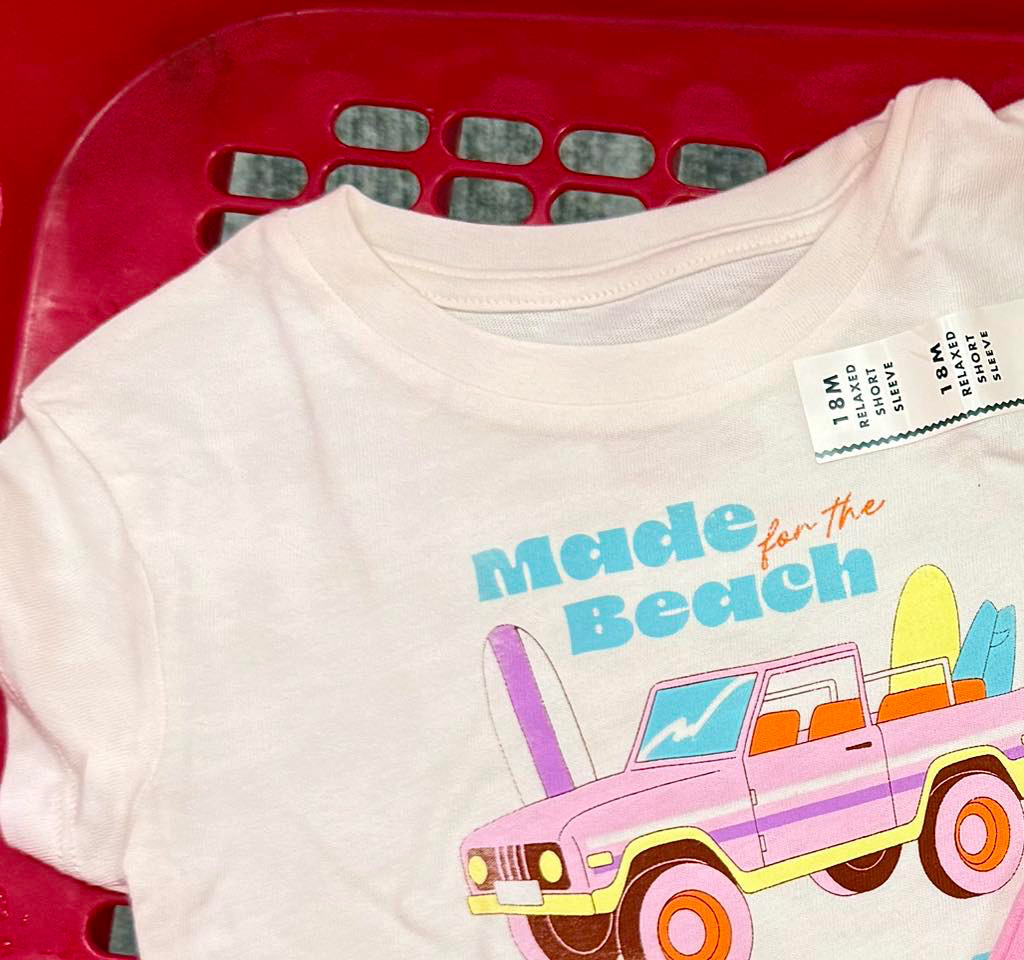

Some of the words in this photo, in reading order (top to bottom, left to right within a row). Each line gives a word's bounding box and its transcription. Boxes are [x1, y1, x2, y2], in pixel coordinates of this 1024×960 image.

[930, 342, 952, 395] 18M
[946, 331, 972, 397] RELAXED
[965, 335, 987, 383] SHORT
[980, 331, 1001, 381] SLEEVE
[823, 374, 848, 425] 18M
[846, 365, 870, 428] RELAXED
[865, 369, 886, 415] SHORT
[883, 362, 904, 412] SLEEVE
[472, 501, 757, 602] Made
[757, 518, 818, 570] for
[820, 491, 885, 538] the
[563, 543, 878, 657] Beach
